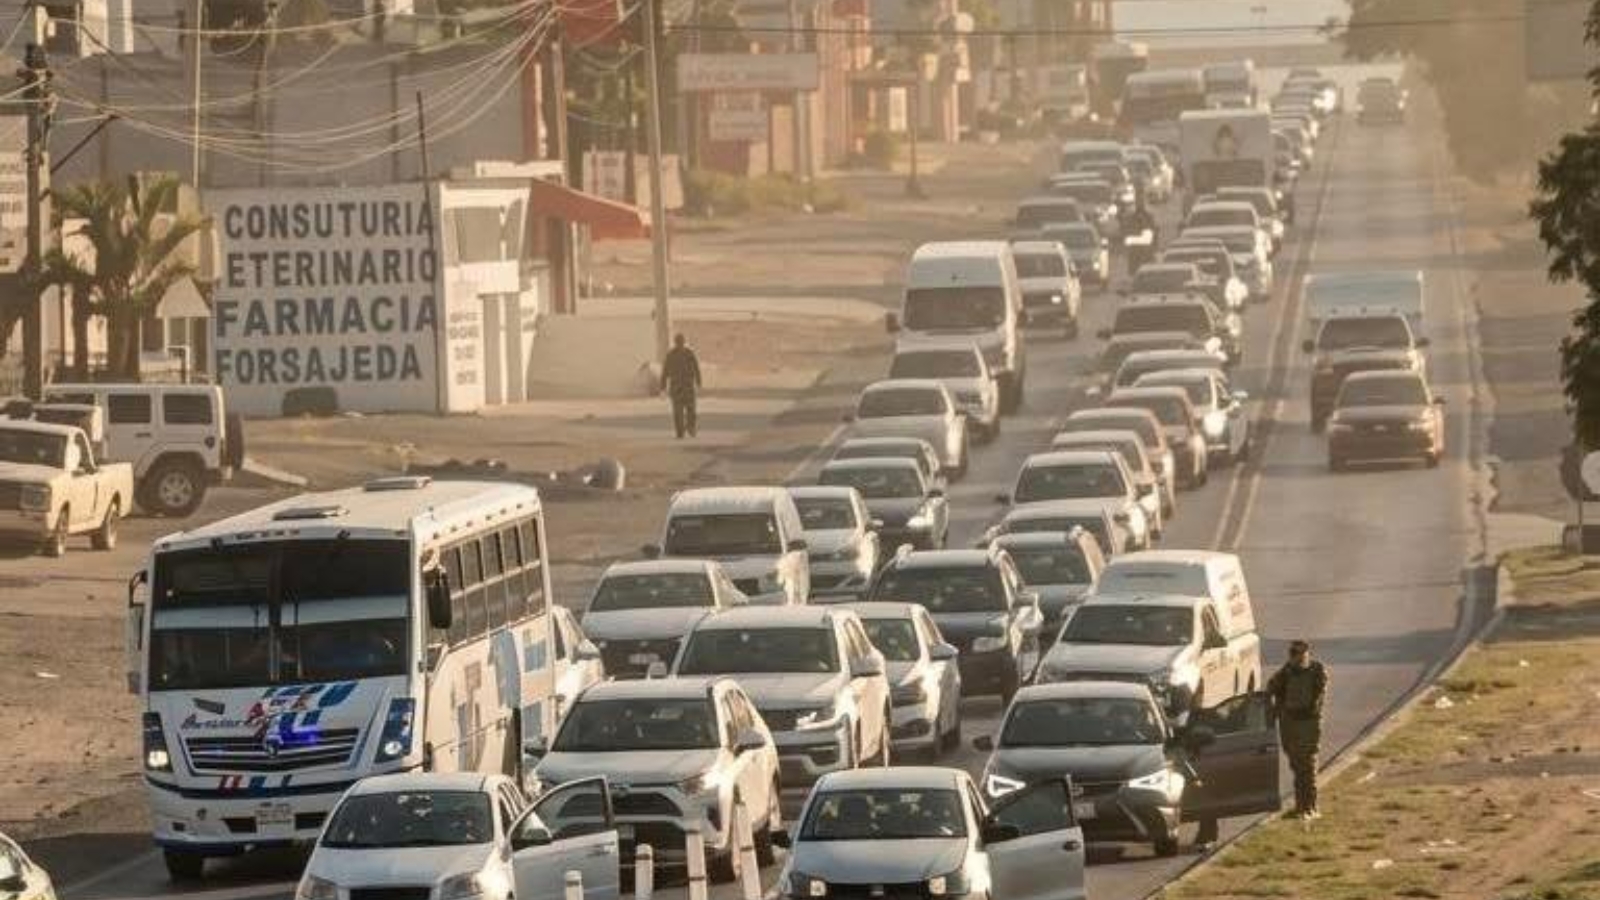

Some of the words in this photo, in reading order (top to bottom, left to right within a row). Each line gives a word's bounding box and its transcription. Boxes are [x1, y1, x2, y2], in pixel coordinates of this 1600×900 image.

[225, 201, 433, 239] CONSUTURIA
[216, 296, 438, 337] FARMACIA
[215, 344, 421, 384] FORSAJEDA
